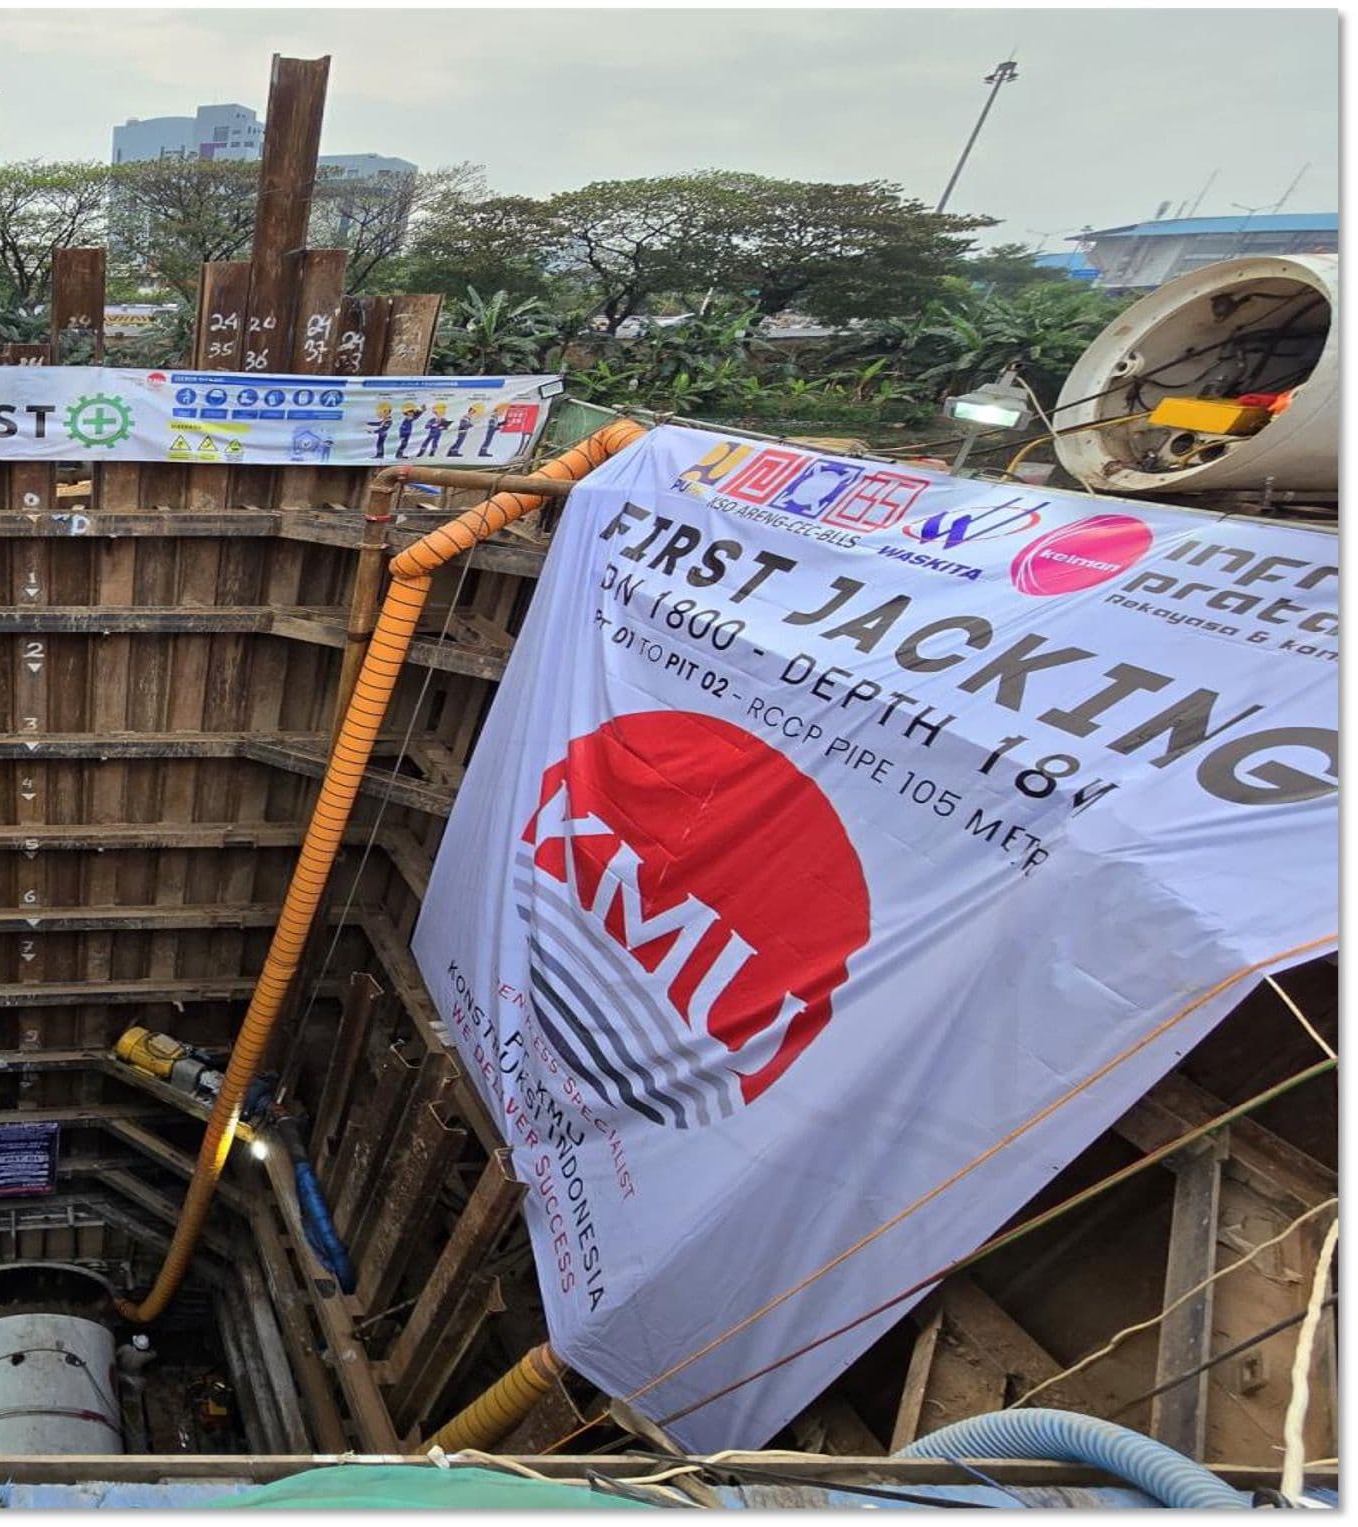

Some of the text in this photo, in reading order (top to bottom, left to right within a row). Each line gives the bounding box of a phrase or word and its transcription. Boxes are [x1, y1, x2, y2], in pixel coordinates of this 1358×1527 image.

[209, 342, 234, 358] 35
[211, 313, 238, 331] 24
[245, 350, 267, 370] 36
[877, 545, 984, 581] WASKITA
[1105, 594, 1239, 637] Rekayasa
[23, 643, 44, 658] 2
[599, 502, 1338, 805] FIRST JACKING
[601, 564, 644, 607] DN
[650, 590, 746, 651] 1800
[779, 653, 957, 747] DEPTH
[23, 717, 38, 730] 3
[640, 637, 663, 663] TO
[664, 653, 699, 681] PIT
[701, 671, 729, 699] 02
[746, 697, 823, 744] RCCP
[823, 737, 895, 784] PIPE
[899, 771, 962, 818] 105
[964, 809, 1050, 877] METR
[533, 779, 809, 1075] KMU
[536, 1080, 585, 1146] KMU
[562, 1077, 635, 1201] SPECIALIST
[452, 1003, 472, 1042] WE
[535, 1154, 575, 1294] SUCCESS
[548, 1125, 605, 1312] INDONESIA
